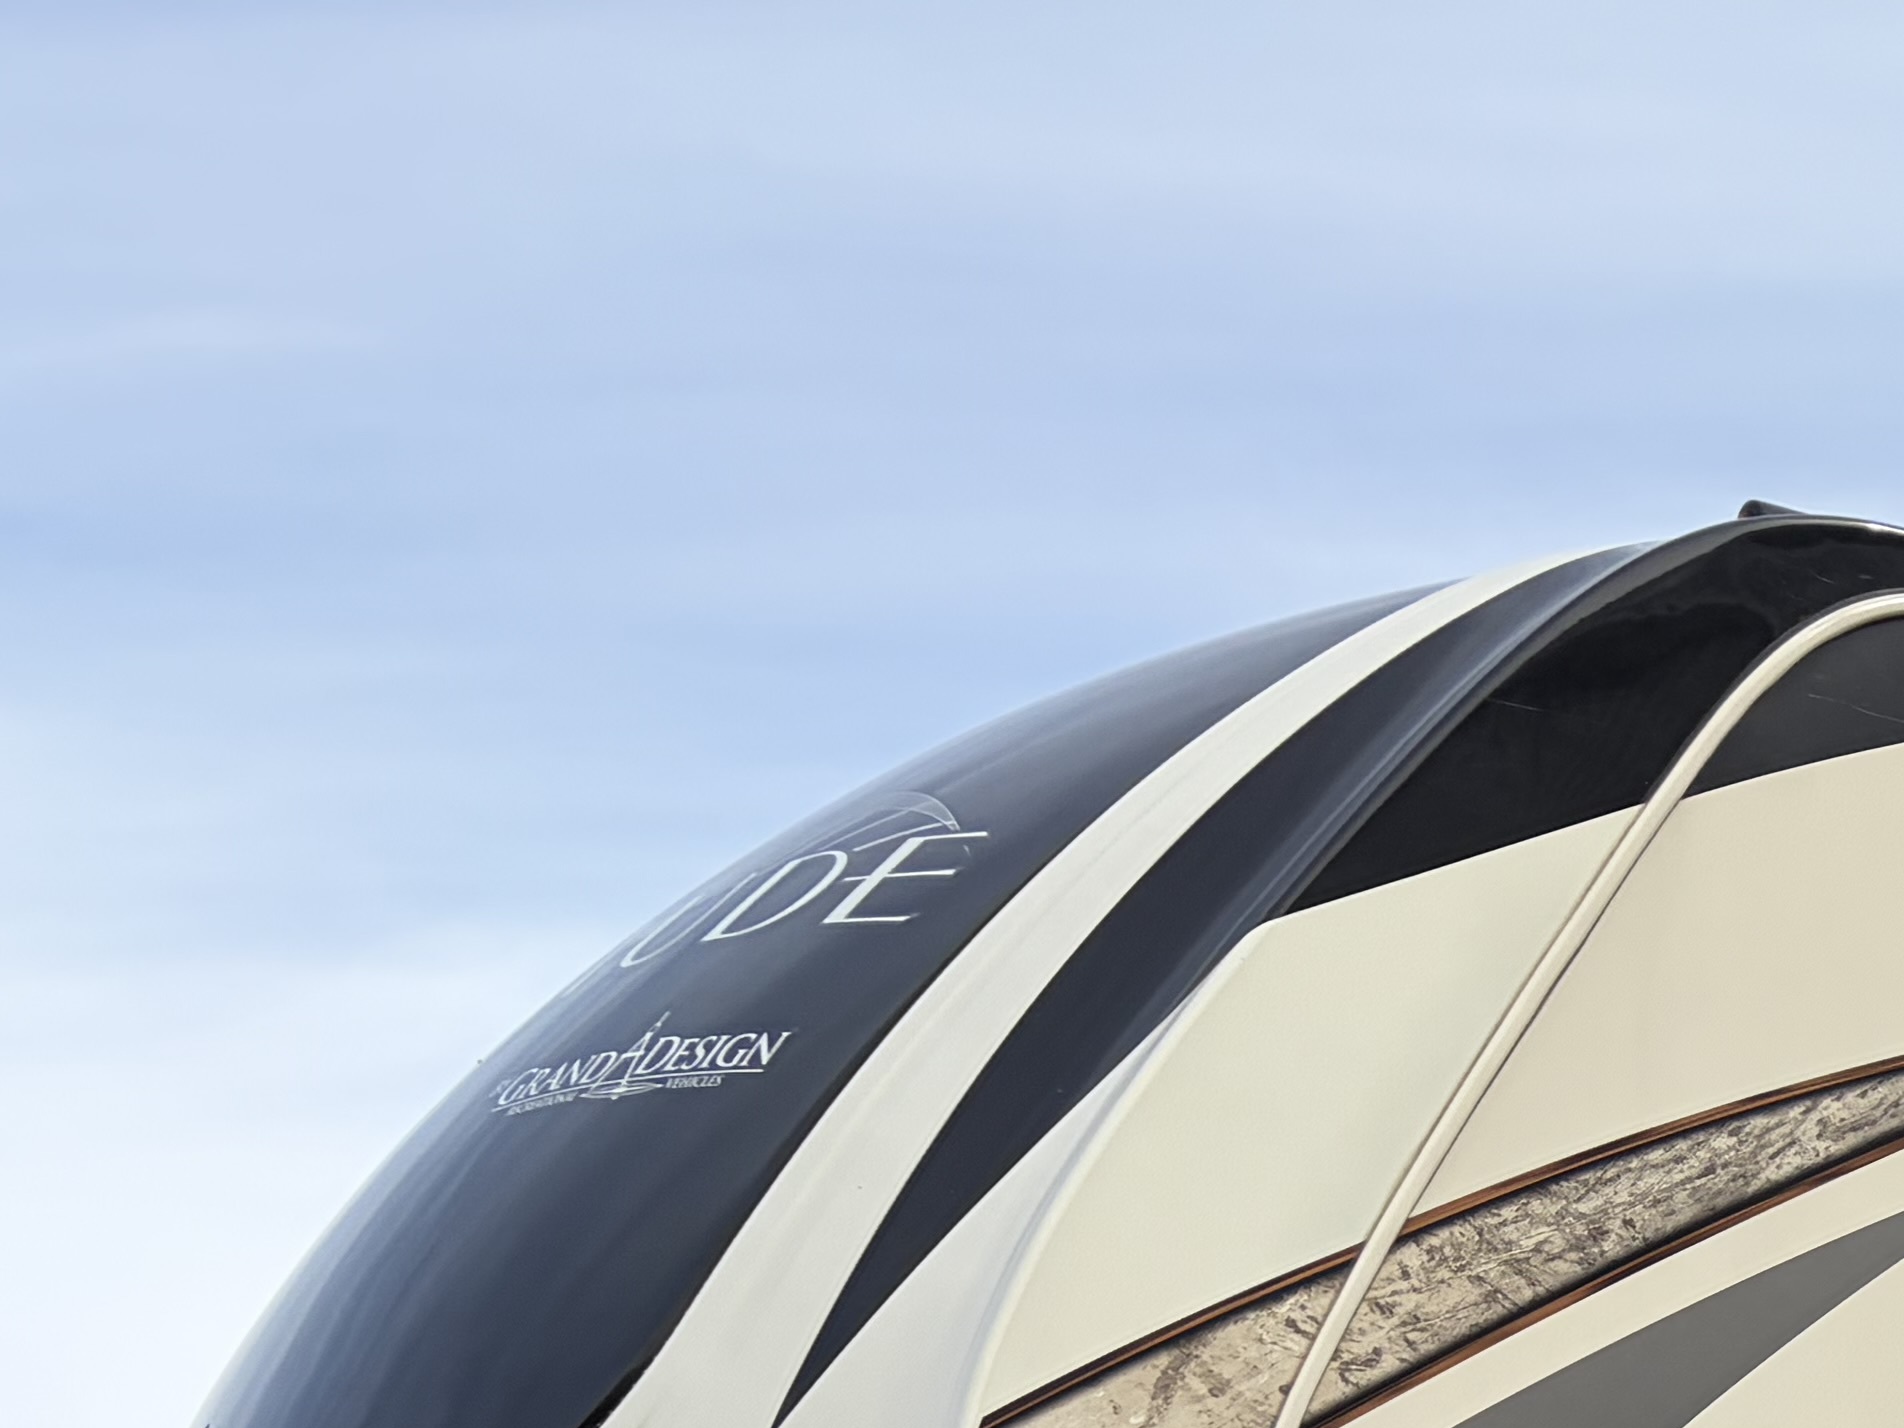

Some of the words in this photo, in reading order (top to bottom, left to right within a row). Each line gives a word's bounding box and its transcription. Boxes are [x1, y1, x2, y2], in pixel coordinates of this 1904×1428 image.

[562, 829, 989, 998] UDE
[498, 1050, 619, 1106] GRAND
[636, 1031, 792, 1076] DESIGN
